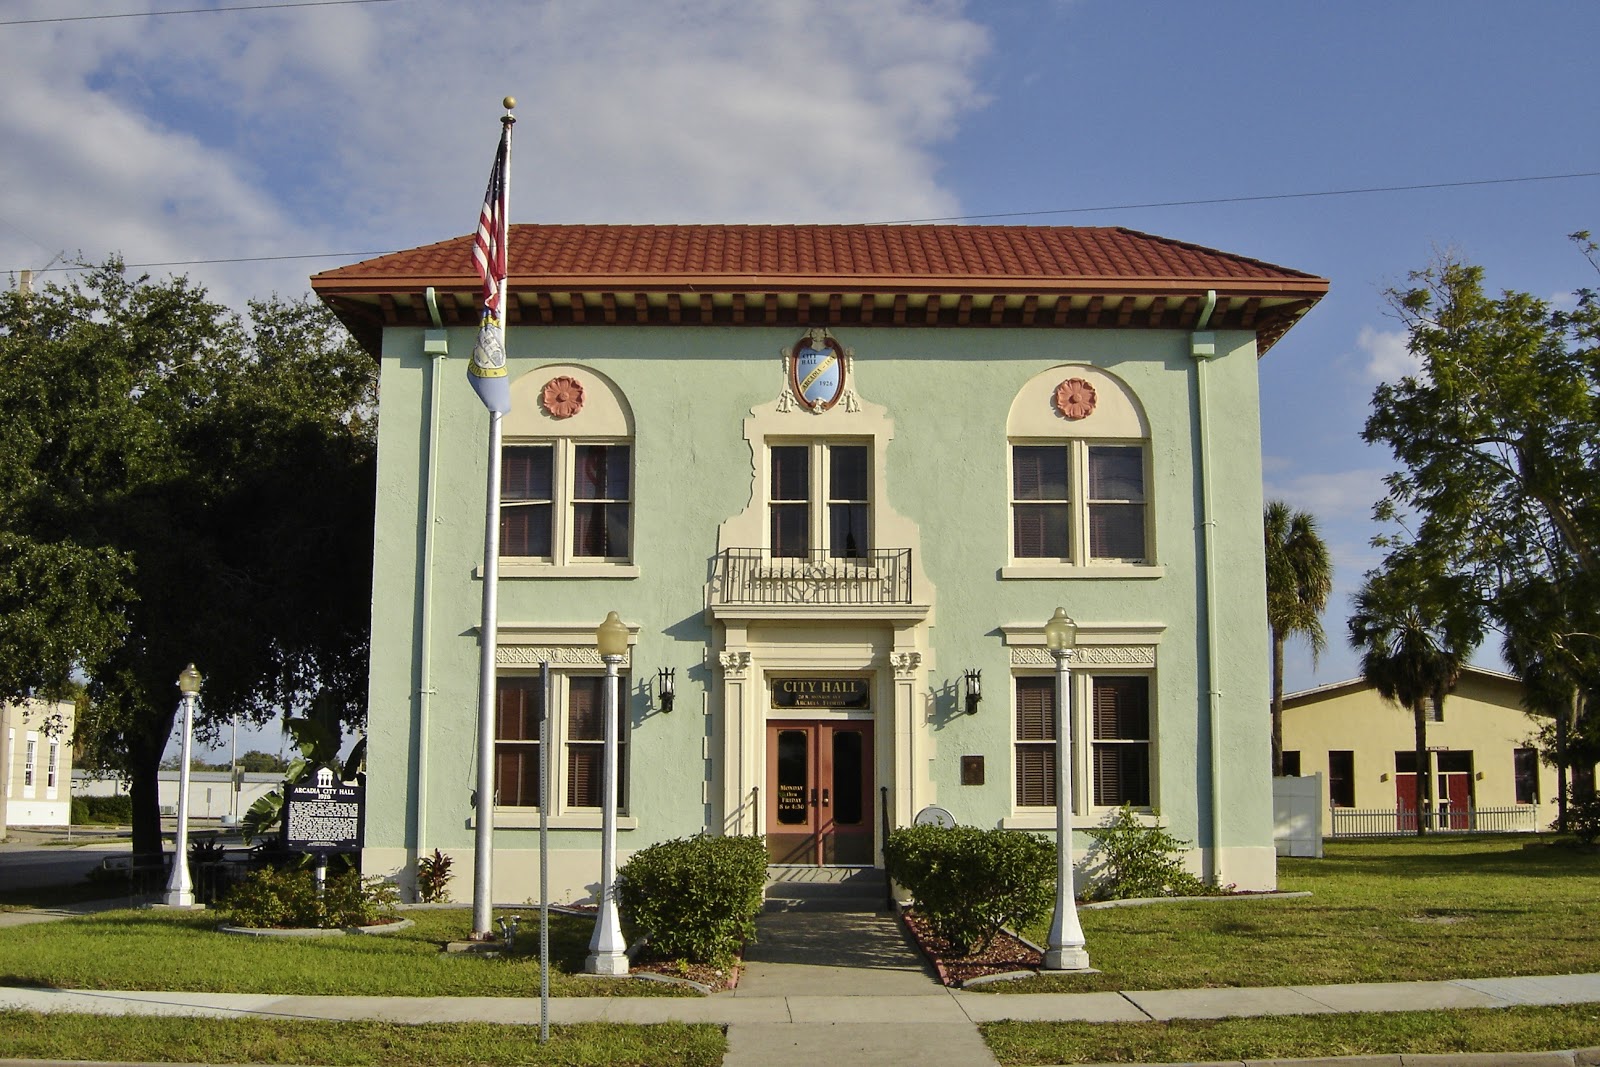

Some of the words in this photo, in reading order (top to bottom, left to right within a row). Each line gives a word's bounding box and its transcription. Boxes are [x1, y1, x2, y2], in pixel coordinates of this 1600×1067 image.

[802, 368, 822, 388] ARCADIA
[783, 681, 816, 693] CITY
[822, 681, 858, 693] HALL
